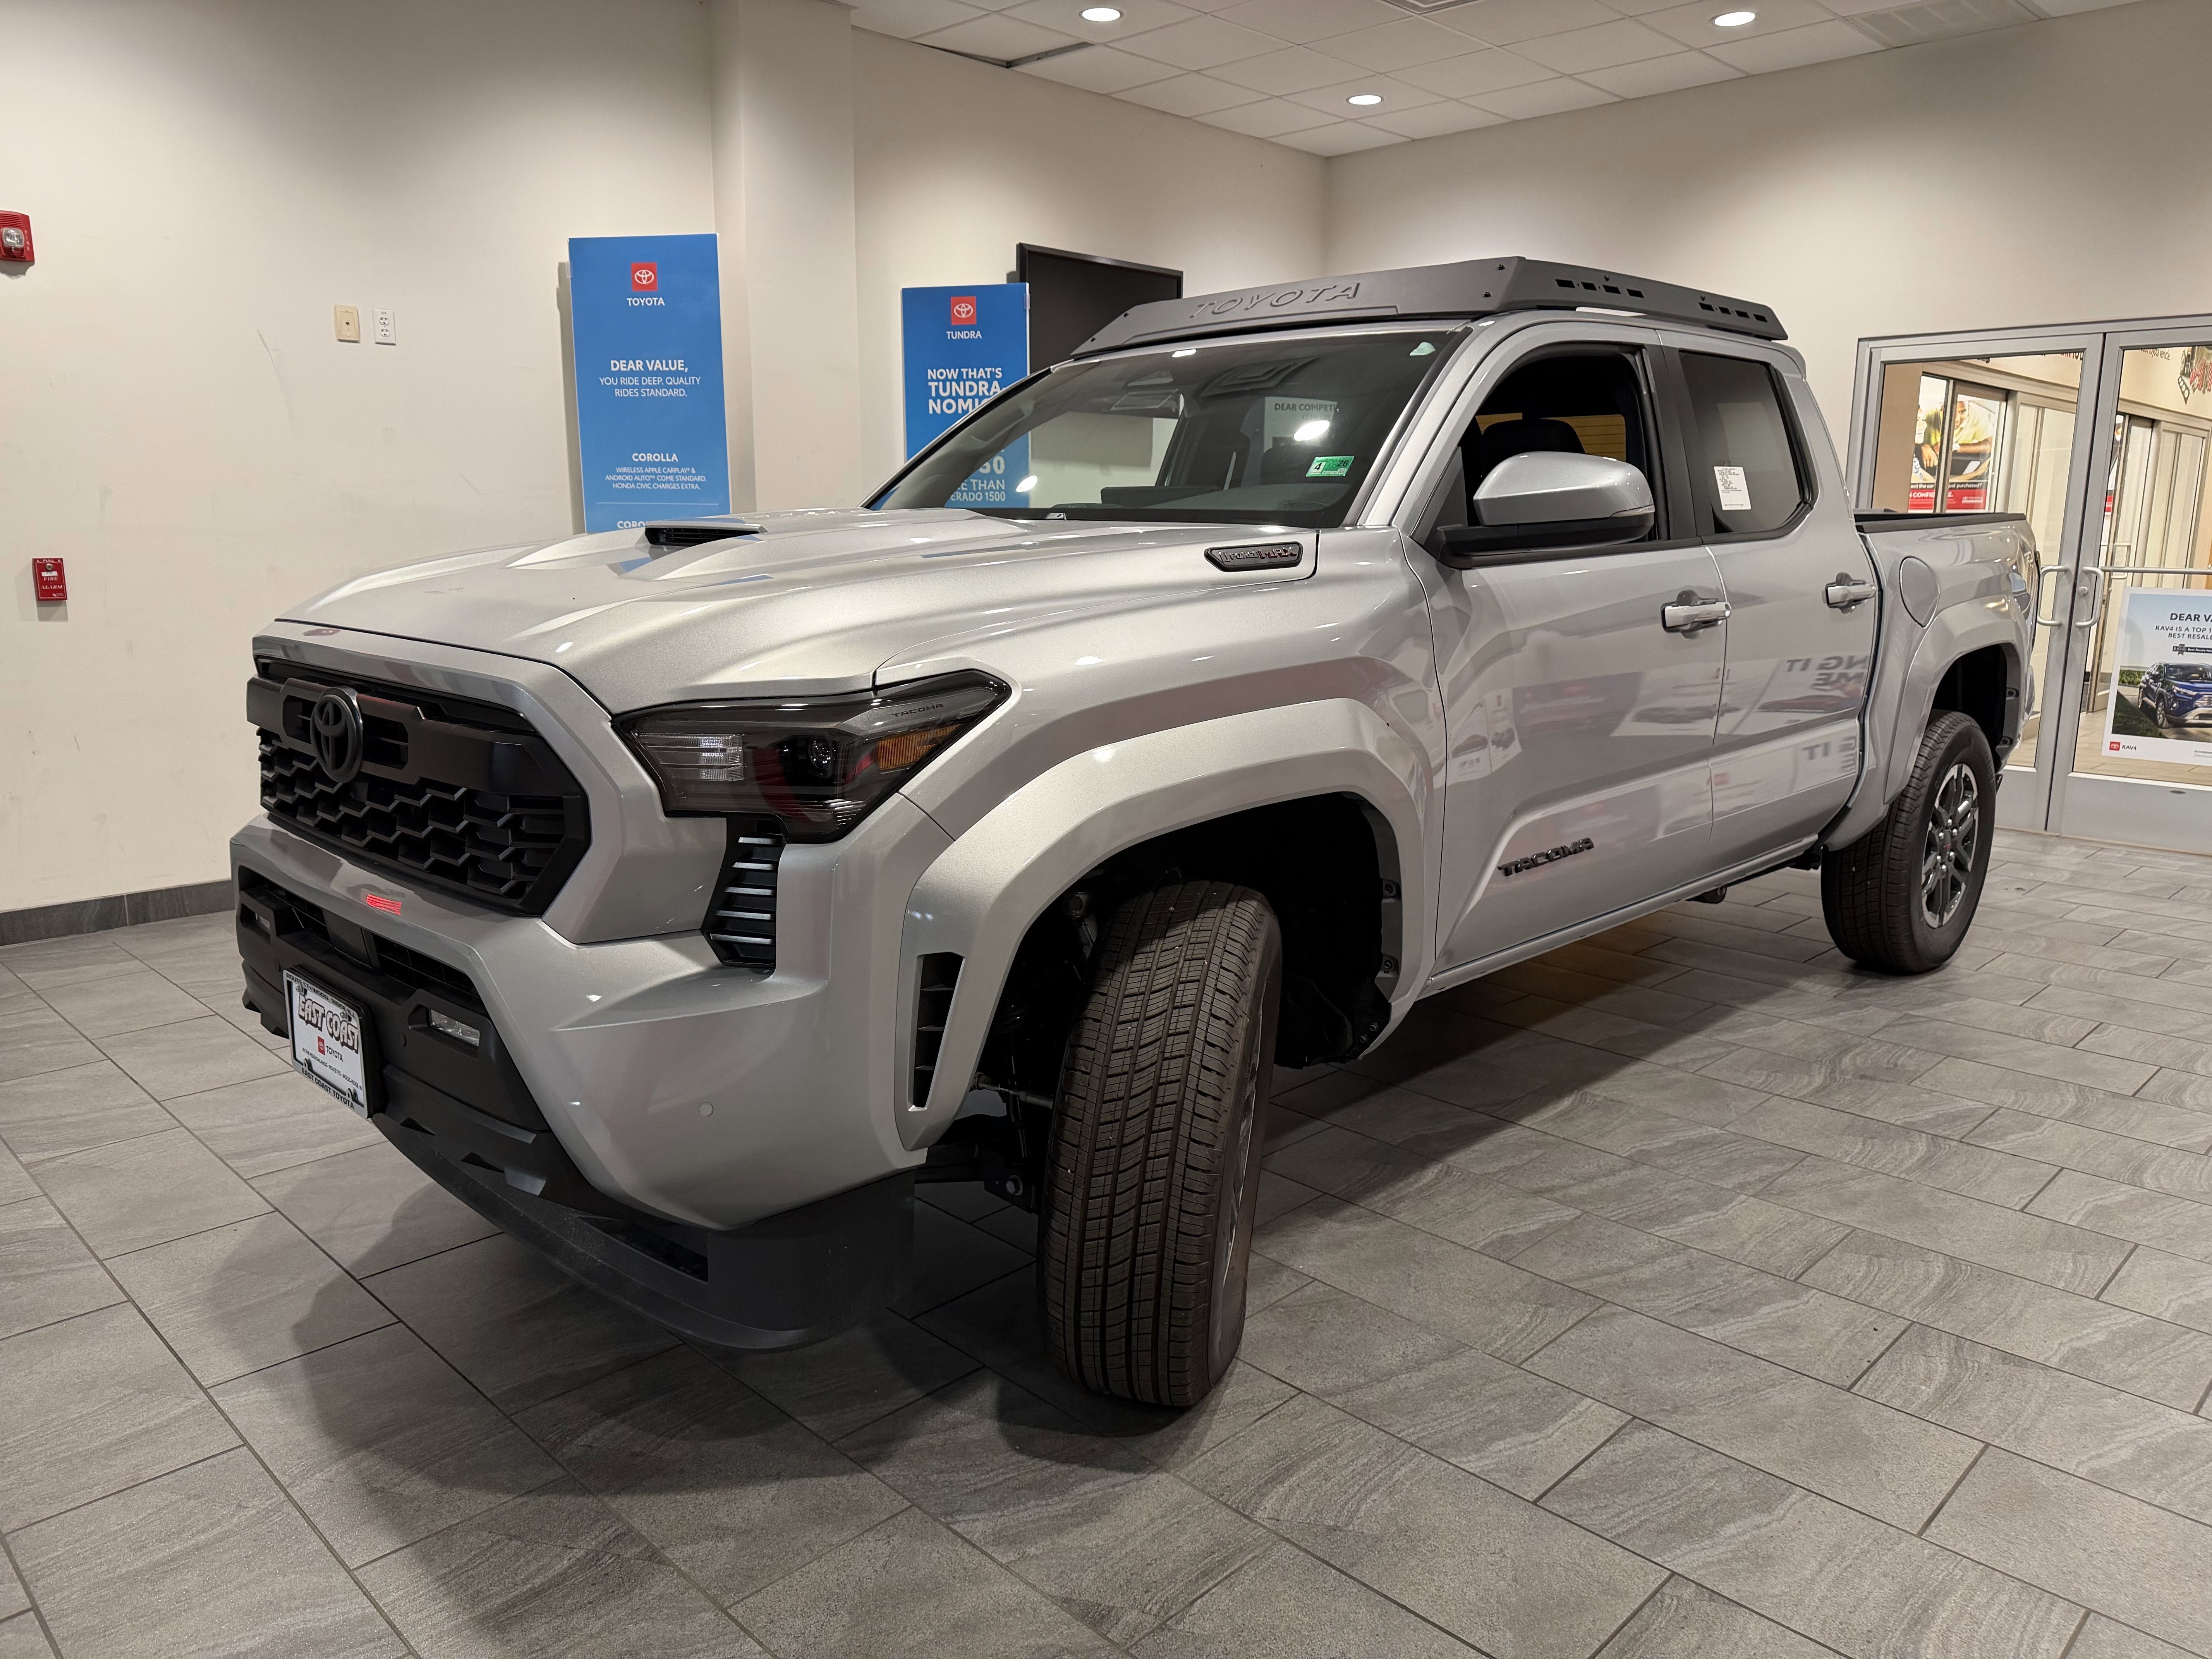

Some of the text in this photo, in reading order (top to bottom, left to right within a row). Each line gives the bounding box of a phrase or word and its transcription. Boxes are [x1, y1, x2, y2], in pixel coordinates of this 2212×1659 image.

[626, 297, 665, 306] TOYOTA
[1189, 282, 1361, 318] TOYOTA
[946, 330, 982, 339] TUNDRA
[610, 359, 688, 373] DEAR VALUE,
[927, 368, 1003, 380] NOW THAT'S
[599, 376, 701, 385] YOU RIDE DEEP. QUALITY
[615, 388, 687, 397] RIDES STANDARD.
[928, 398, 990, 414] NOMI
[1274, 403, 1297, 411] DEAR
[632, 453, 678, 462] COROLLA
[1314, 462, 1322, 471] 4
[970, 479, 1005, 491] THAN
[985, 491, 1006, 501] 1500
[2170, 613, 2200, 622] DEAR
[891, 703, 944, 717] TACOMA
[1498, 838, 1594, 876] TACOMA
[298, 993, 359, 1055] EAST COAST
[326, 1045, 343, 1063] TOYOTA
[302, 1068, 354, 1109] EAST COAST TOYOTA
